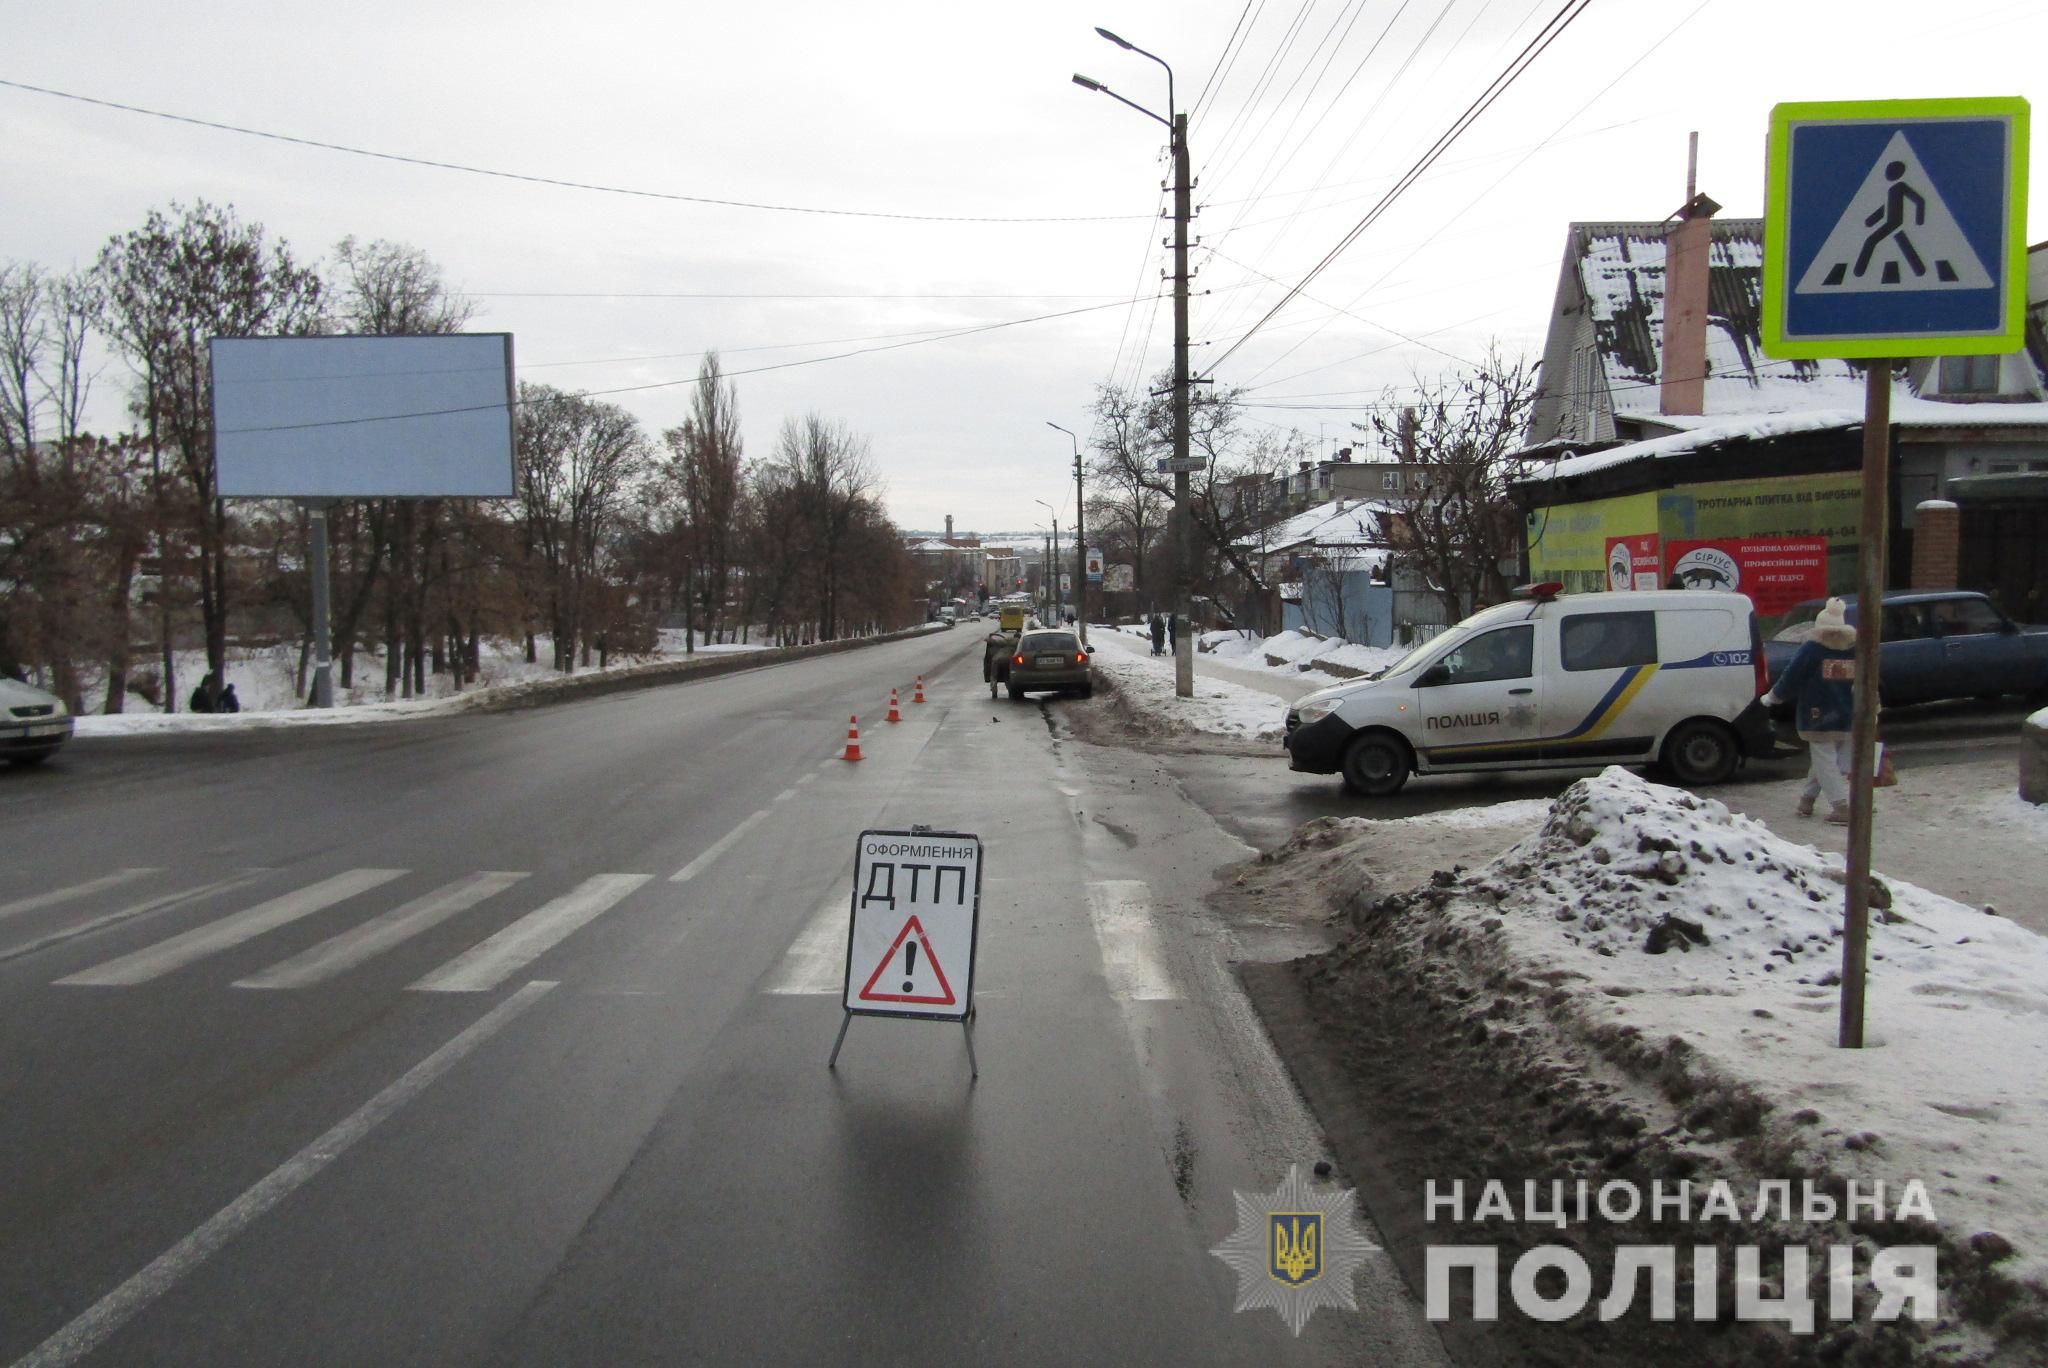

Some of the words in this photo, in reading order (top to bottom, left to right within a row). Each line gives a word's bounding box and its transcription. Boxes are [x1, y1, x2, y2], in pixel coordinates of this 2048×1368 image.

[1695, 552, 1731, 569] СІРІУС
[1728, 653, 1750, 664] 102
[1427, 712, 1500, 730] ПОЛІЦІЯ
[866, 843, 973, 859] ОФОРМЛЕННЯ
[861, 862, 966, 910] ДТП
